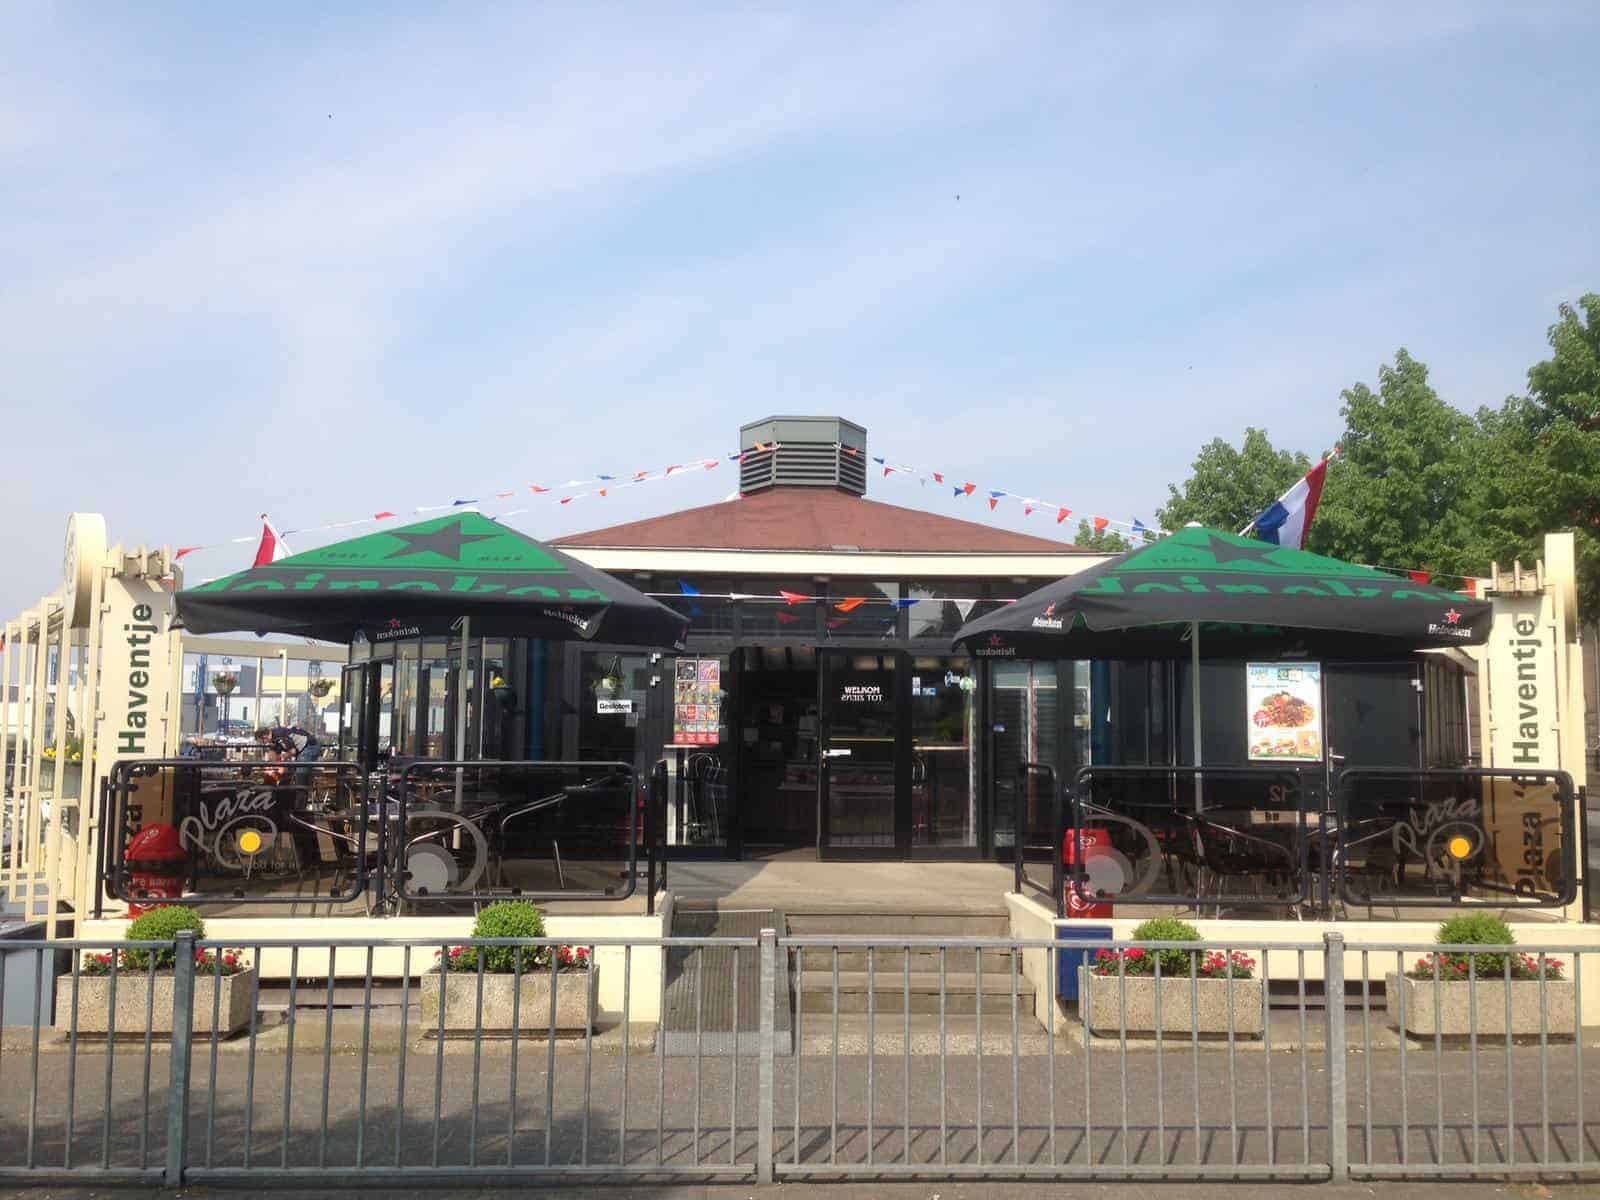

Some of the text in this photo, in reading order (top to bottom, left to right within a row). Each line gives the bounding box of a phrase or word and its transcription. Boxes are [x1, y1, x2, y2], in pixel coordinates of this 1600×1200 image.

[117, 603, 159, 754] Haventje
[844, 686, 880, 694] WELKOM
[1509, 618, 1542, 764] Haventje
[180, 789, 277, 853] Plaza
[1392, 798, 1480, 858] Plaza
